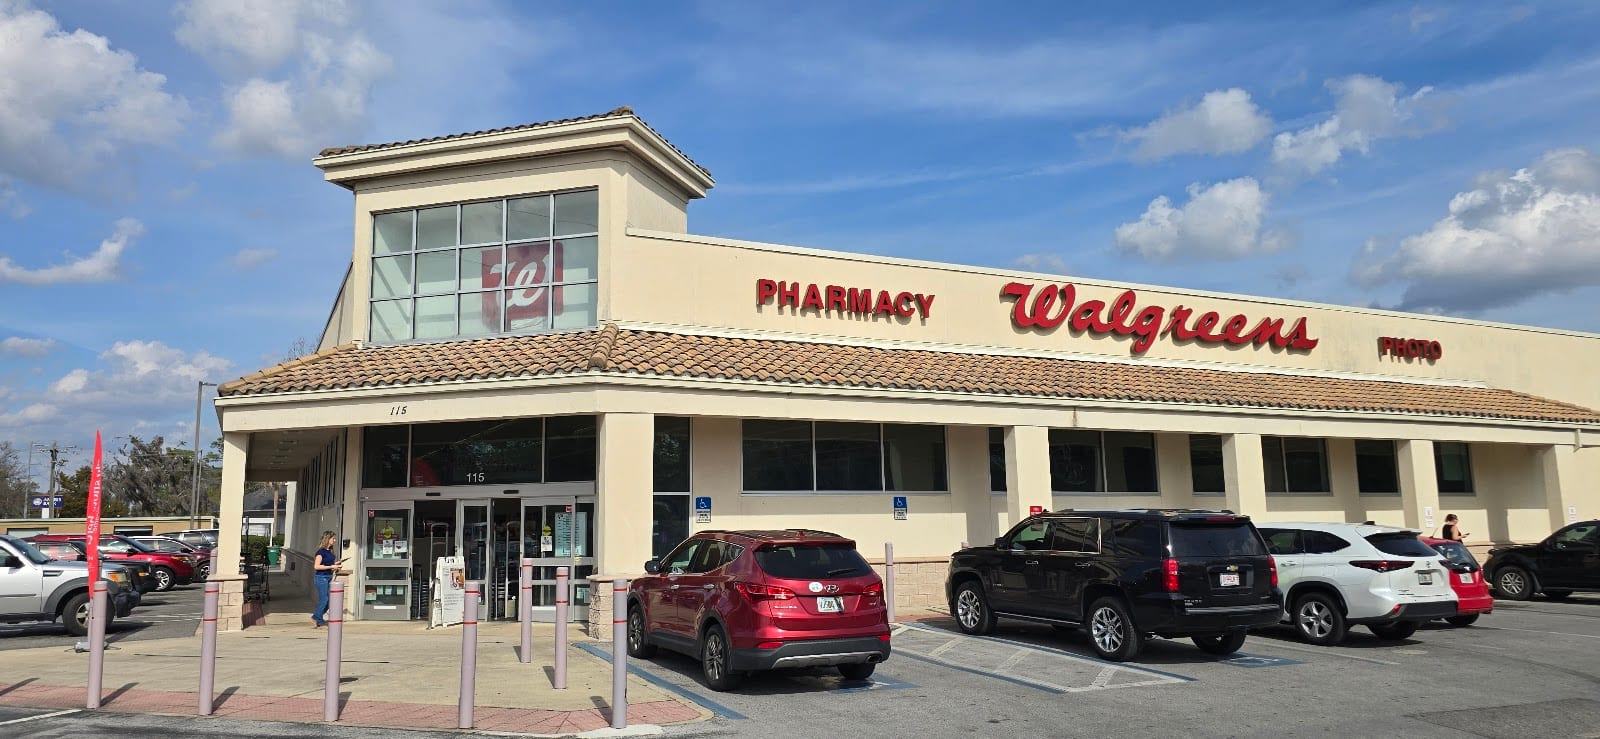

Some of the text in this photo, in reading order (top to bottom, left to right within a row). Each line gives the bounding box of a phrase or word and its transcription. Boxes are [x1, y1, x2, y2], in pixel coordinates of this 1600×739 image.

[757, 278, 936, 319] PHARMACY
[1000, 282, 1318, 353] Walgreens
[1380, 337, 1442, 360] PHOTO
[390, 405, 408, 415] 115
[466, 472, 485, 483] 115
